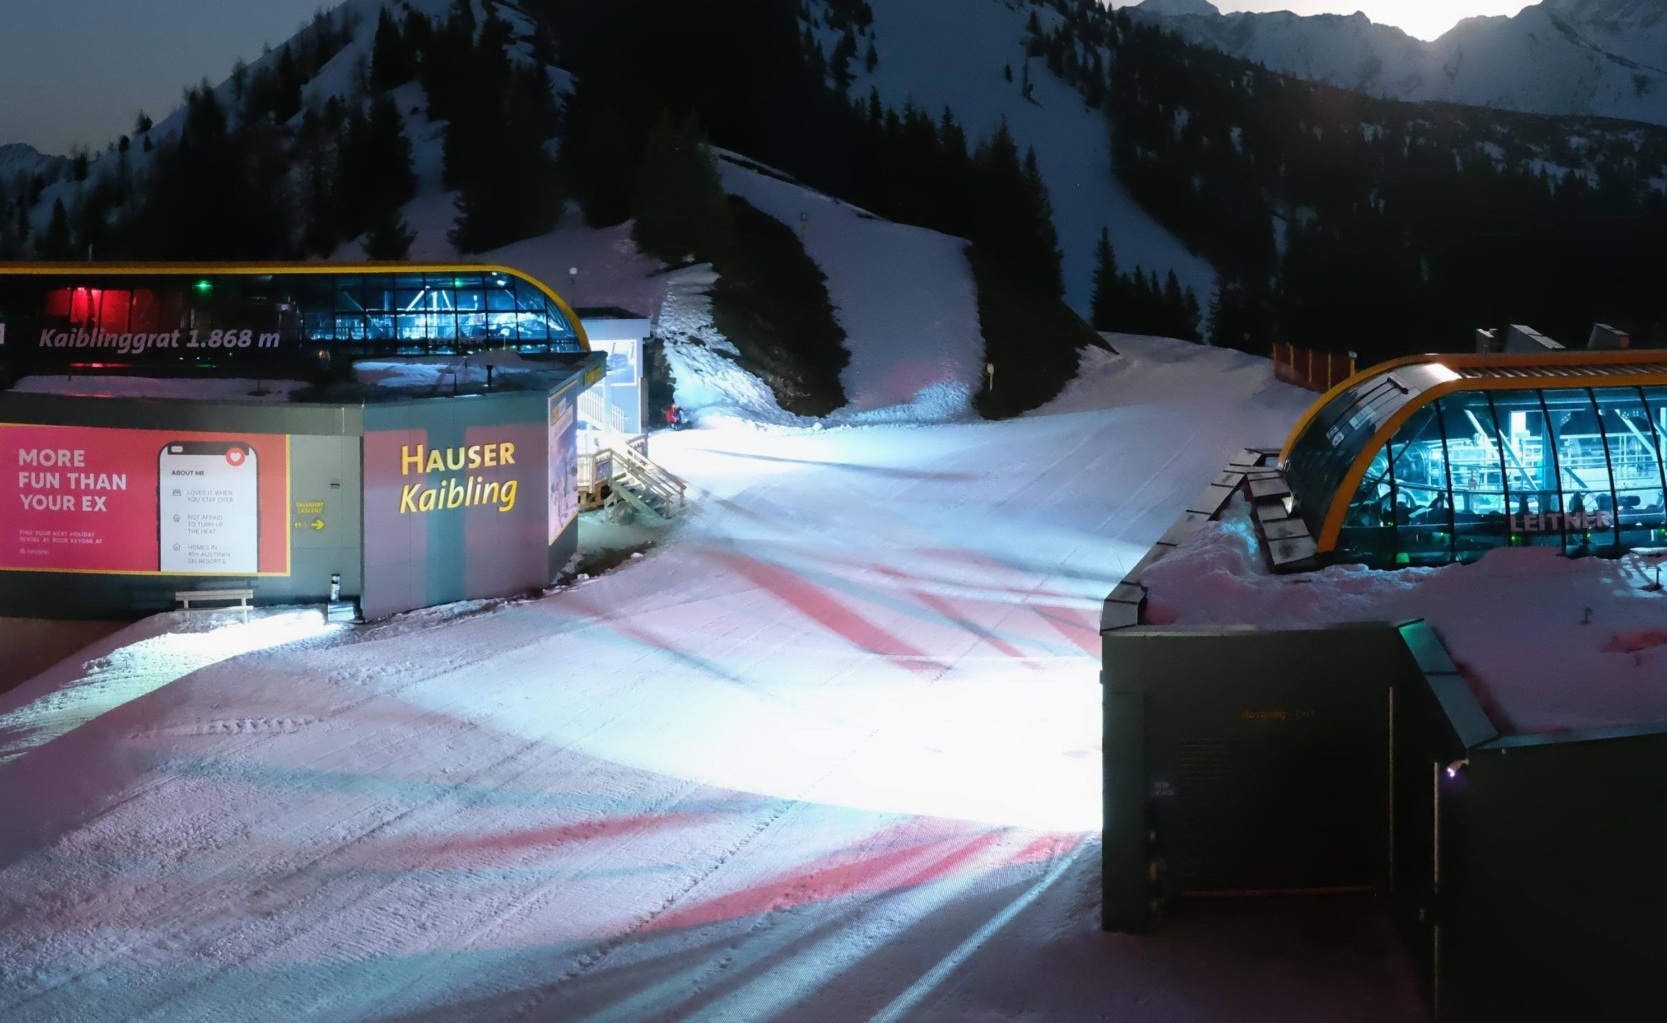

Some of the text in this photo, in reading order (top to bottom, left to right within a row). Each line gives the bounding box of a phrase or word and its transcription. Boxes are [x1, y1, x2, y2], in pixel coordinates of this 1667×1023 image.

[39, 327, 281, 355] Kaiblinggrat 1.868 m
[18, 448, 85, 467] MORE
[401, 442, 516, 475] HAUSER
[18, 471, 127, 490] FUN THAN
[19, 494, 107, 512] YOUR EX
[400, 476, 518, 513] Kaibling
[1510, 511, 1611, 532] LEITNER
